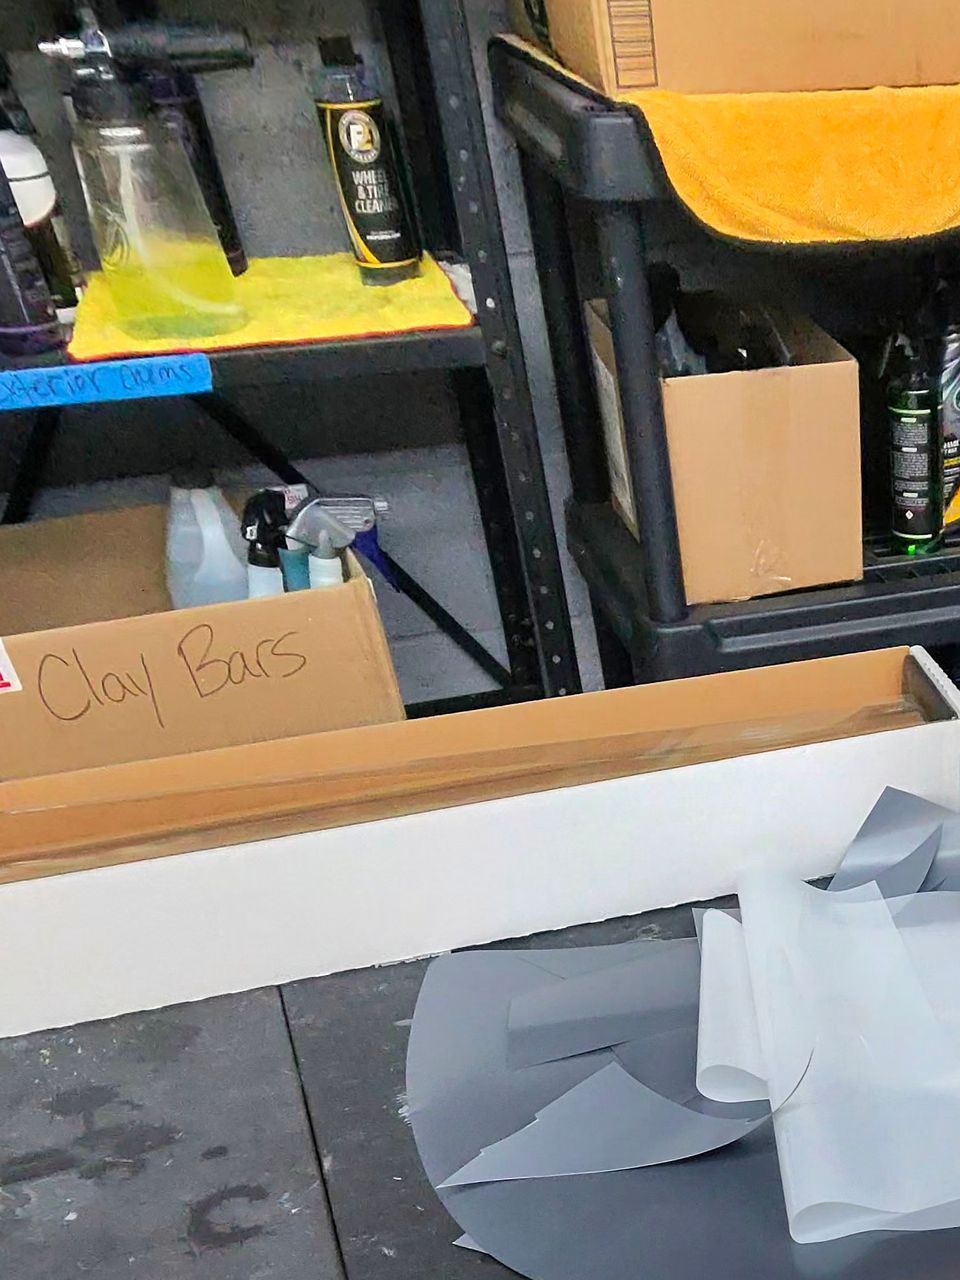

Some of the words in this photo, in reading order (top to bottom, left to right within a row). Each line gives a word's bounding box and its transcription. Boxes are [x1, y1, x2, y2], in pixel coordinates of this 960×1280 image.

[0, 369, 101, 403] xterior
[38, 647, 165, 729] Clay
[177, 623, 307, 698] Bars
